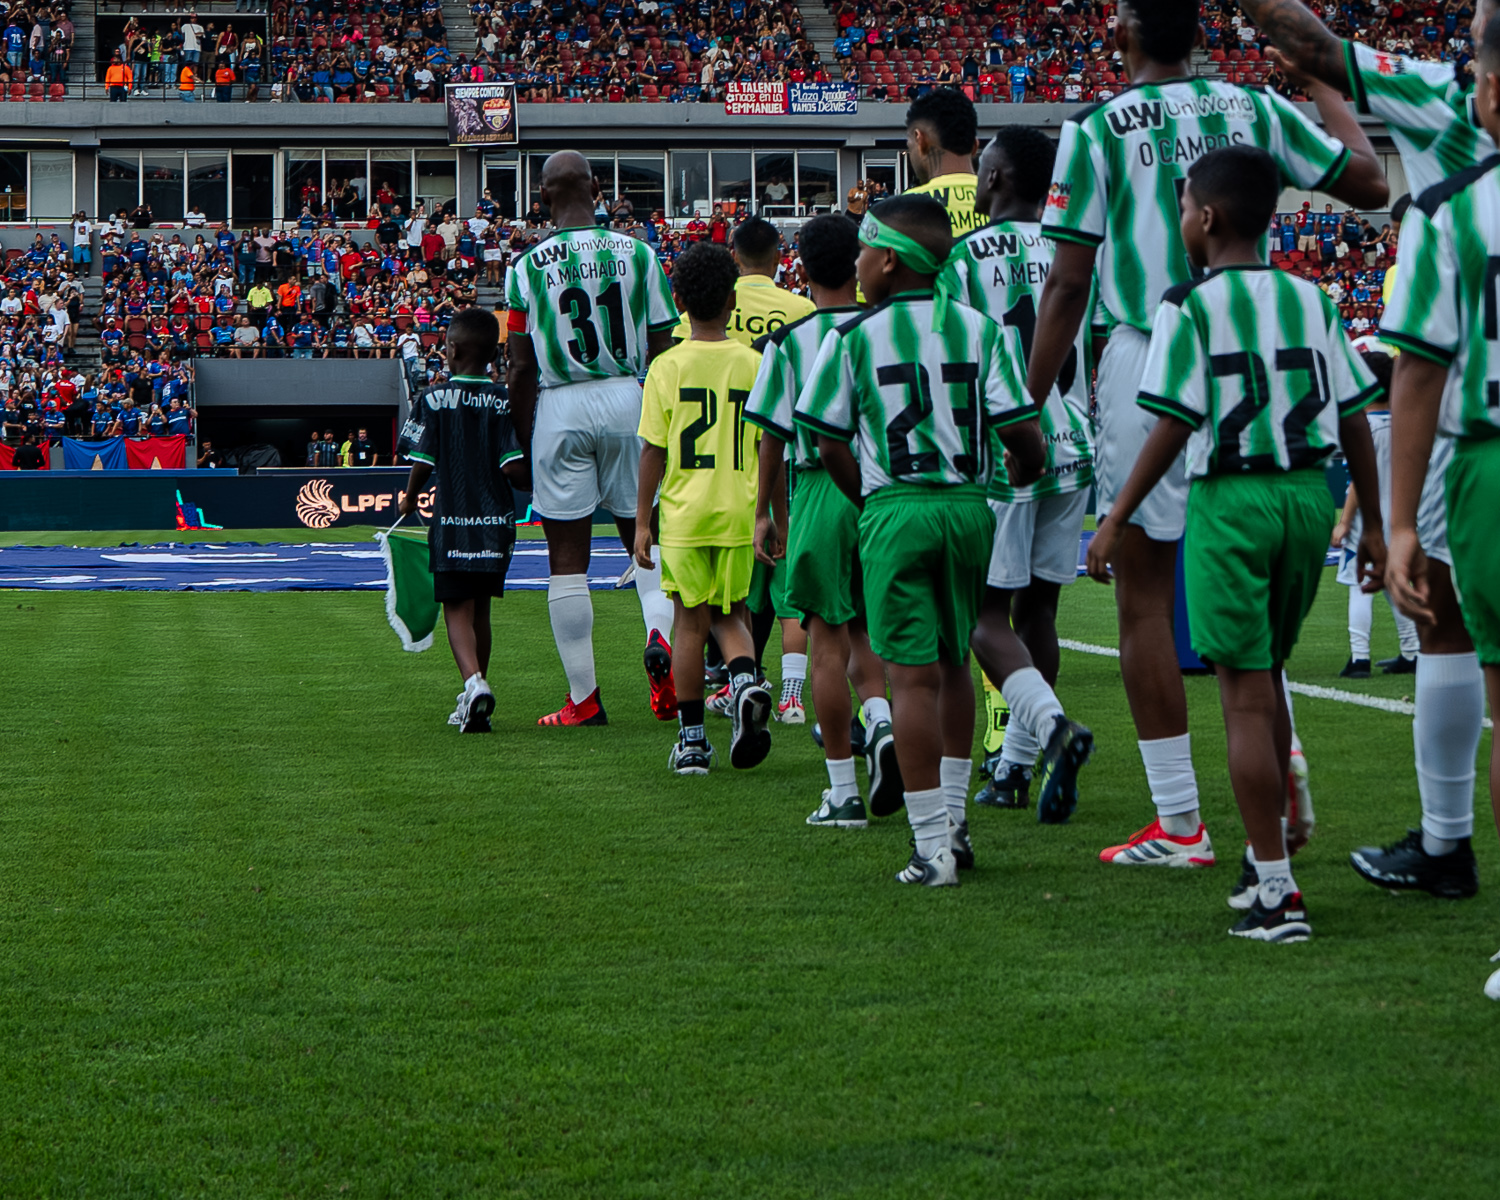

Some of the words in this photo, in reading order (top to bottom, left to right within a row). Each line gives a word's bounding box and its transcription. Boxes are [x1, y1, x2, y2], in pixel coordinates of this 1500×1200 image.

[455, 86, 480, 98] SIEMPRE
[480, 86, 505, 98] CONTIGO
[728, 82, 739, 93] EL
[740, 82, 784, 94] TALENTO
[731, 102, 785, 114] EMMANUEL
[791, 102, 817, 113] VAMOS
[846, 101, 858, 112] 21
[1164, 94, 1254, 118] UniWorld
[570, 237, 633, 252] UniWorld
[546, 259, 627, 289] A.MACHADO
[558, 281, 628, 364] 31
[425, 389, 461, 411] UW
[1208, 346, 1338, 472] 22
[876, 361, 980, 478] 23
[341, 494, 393, 512] LPF
[440, 516, 507, 527] RADIMAGEN
